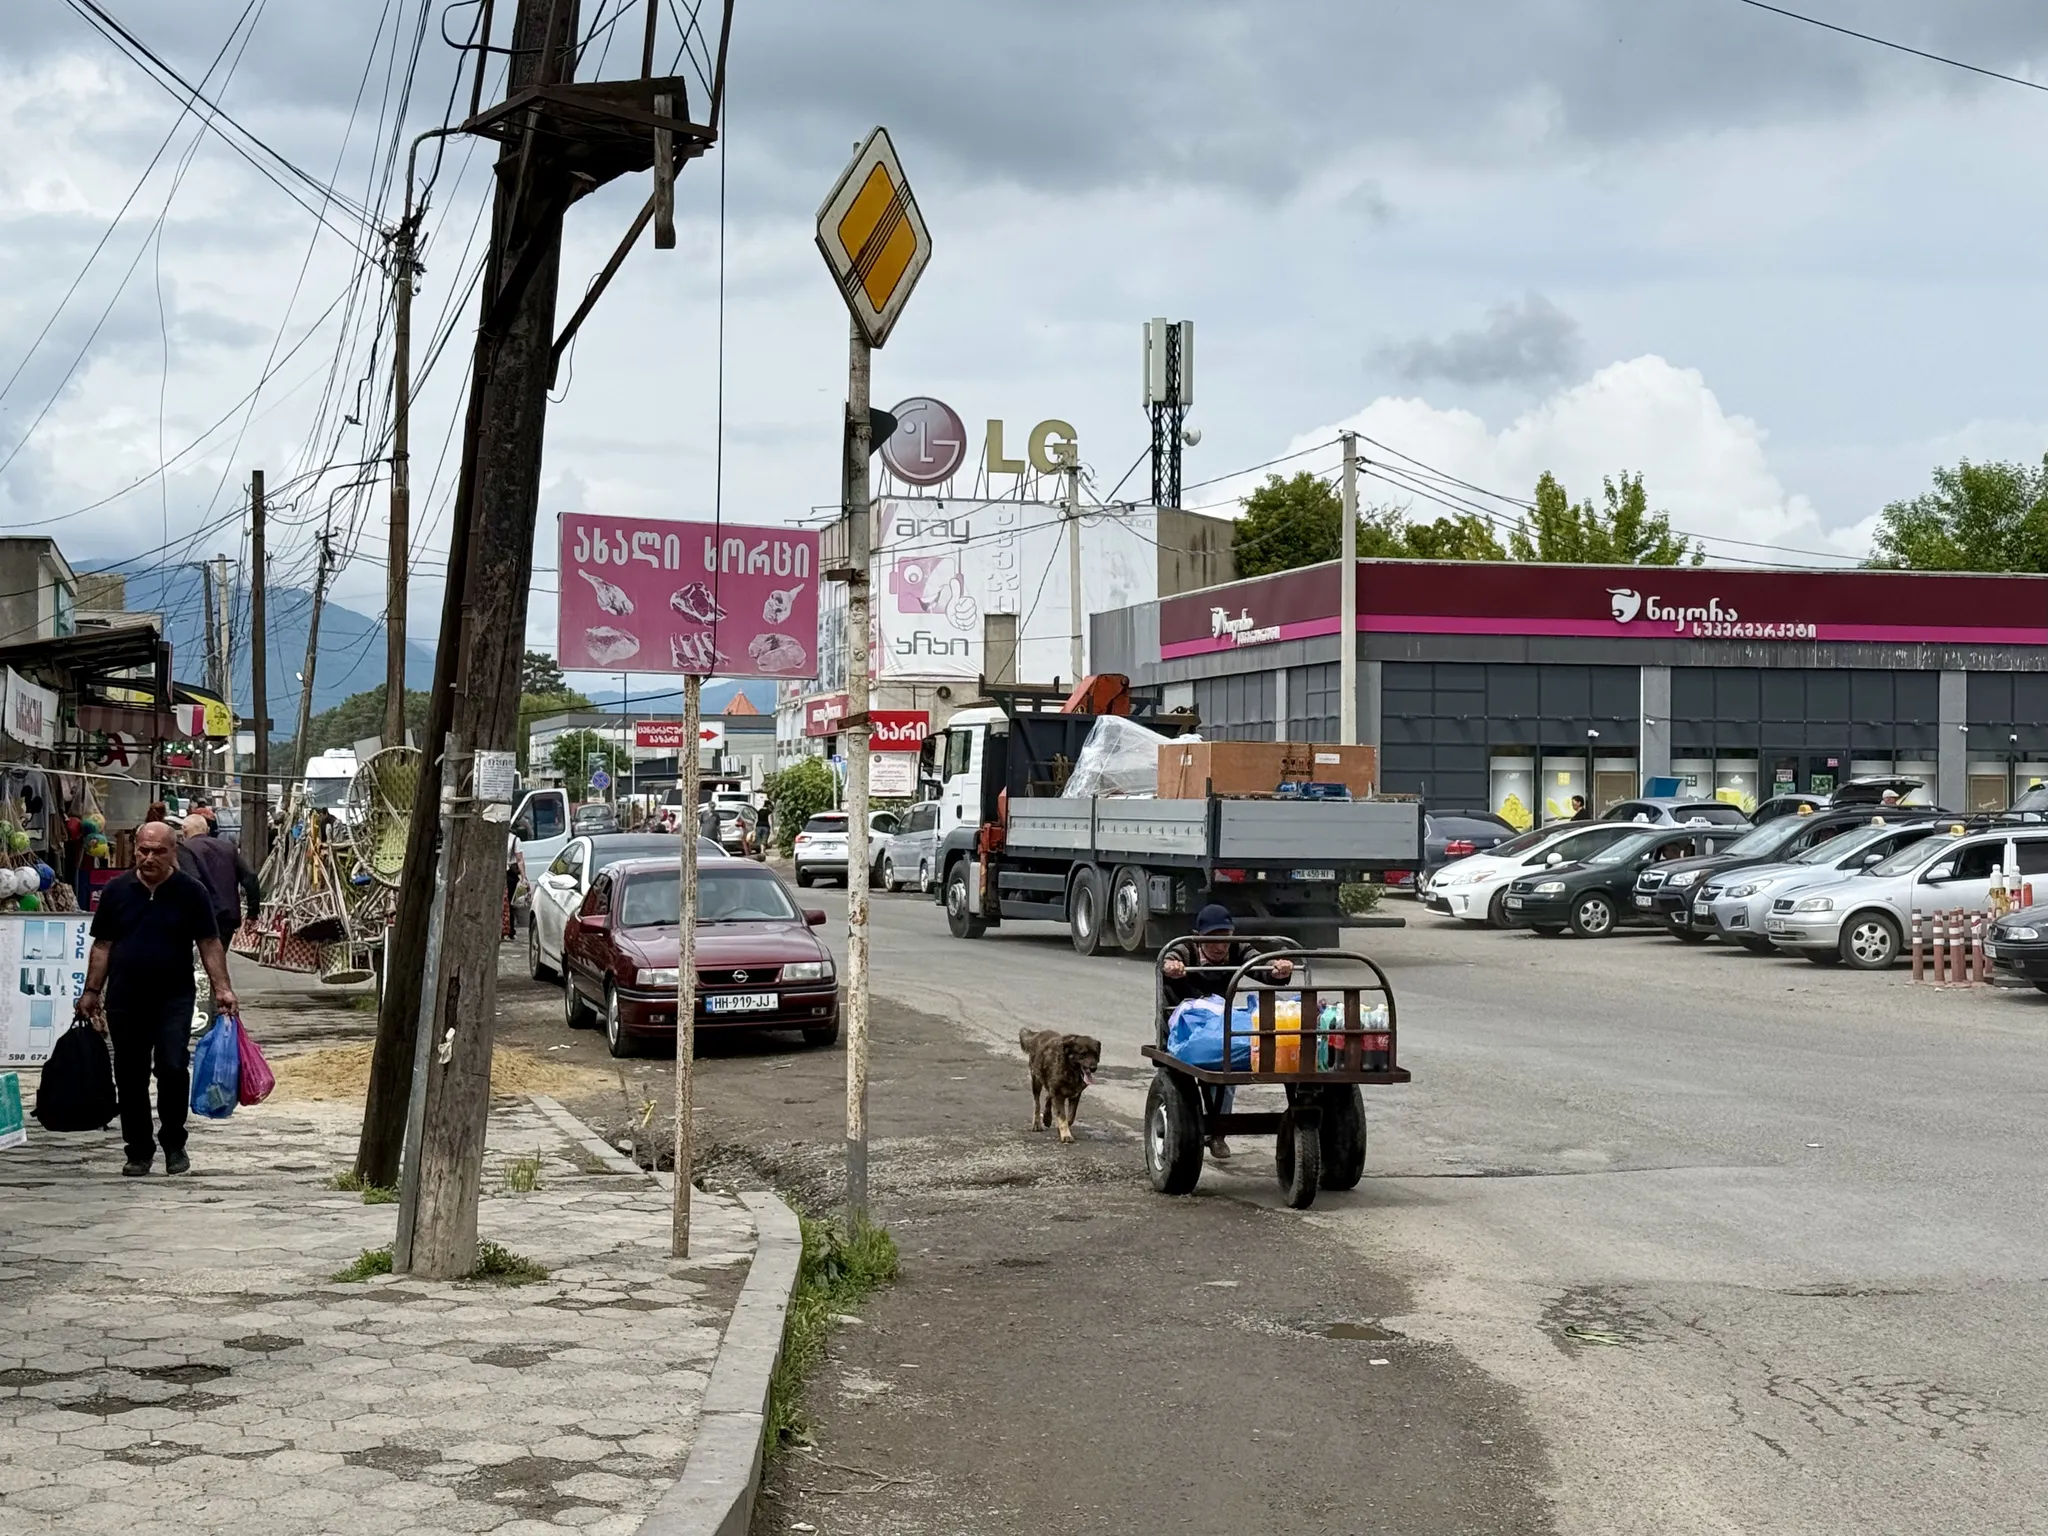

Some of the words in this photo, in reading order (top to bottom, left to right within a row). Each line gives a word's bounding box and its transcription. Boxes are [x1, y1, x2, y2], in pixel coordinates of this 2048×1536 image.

[987, 419, 1078, 475] LG
[896, 518, 970, 544] aray
[573, 526, 681, 570] ახალი
[704, 536, 809, 578] ხორცი
[1646, 596, 1739, 632] ნიკორა
[1693, 622, 1817, 639] სუპერმარკეტი
[714, 995, 770, 1010] HH-919-JJ
[8, 1053, 26, 1061] 598
[30, 1053, 48, 1061] 674
